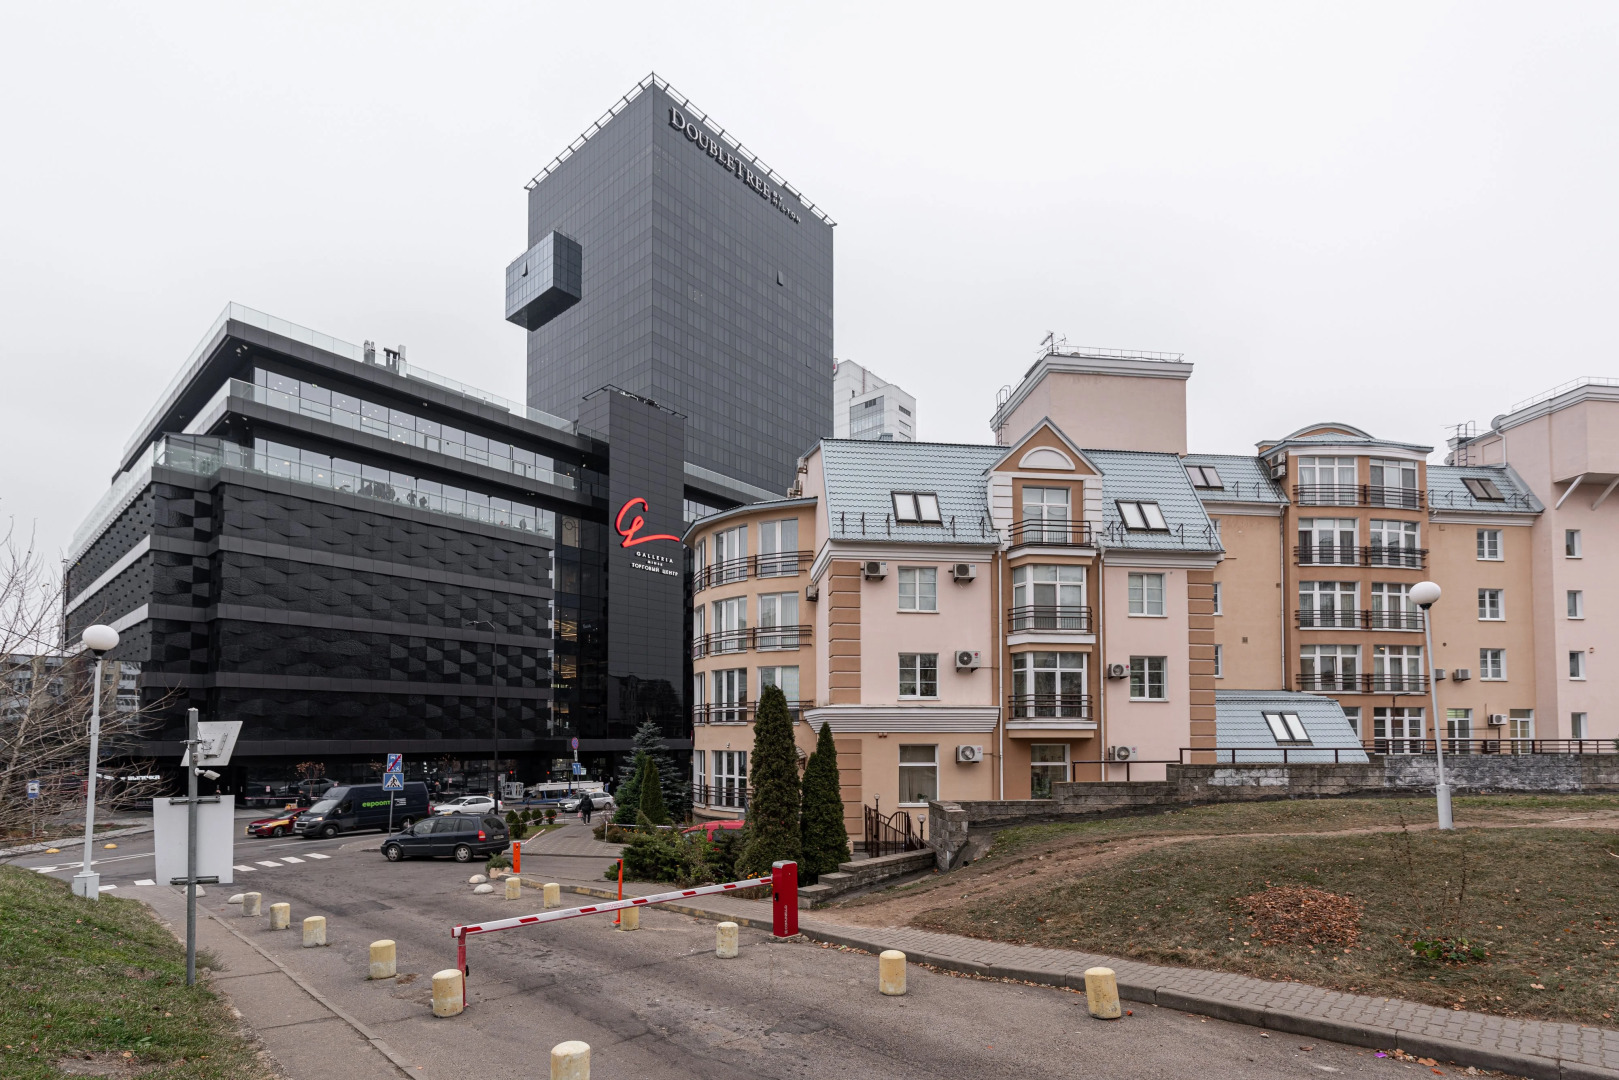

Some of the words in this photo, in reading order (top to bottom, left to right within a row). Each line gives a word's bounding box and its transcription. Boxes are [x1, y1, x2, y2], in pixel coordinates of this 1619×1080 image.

[671, 107, 771, 198] DOUBLETREE
[636, 551, 674, 564] GALLERIA
[632, 563, 660, 573] ТОРГОВЫЙ
[362, 800, 391, 808] евроопт
